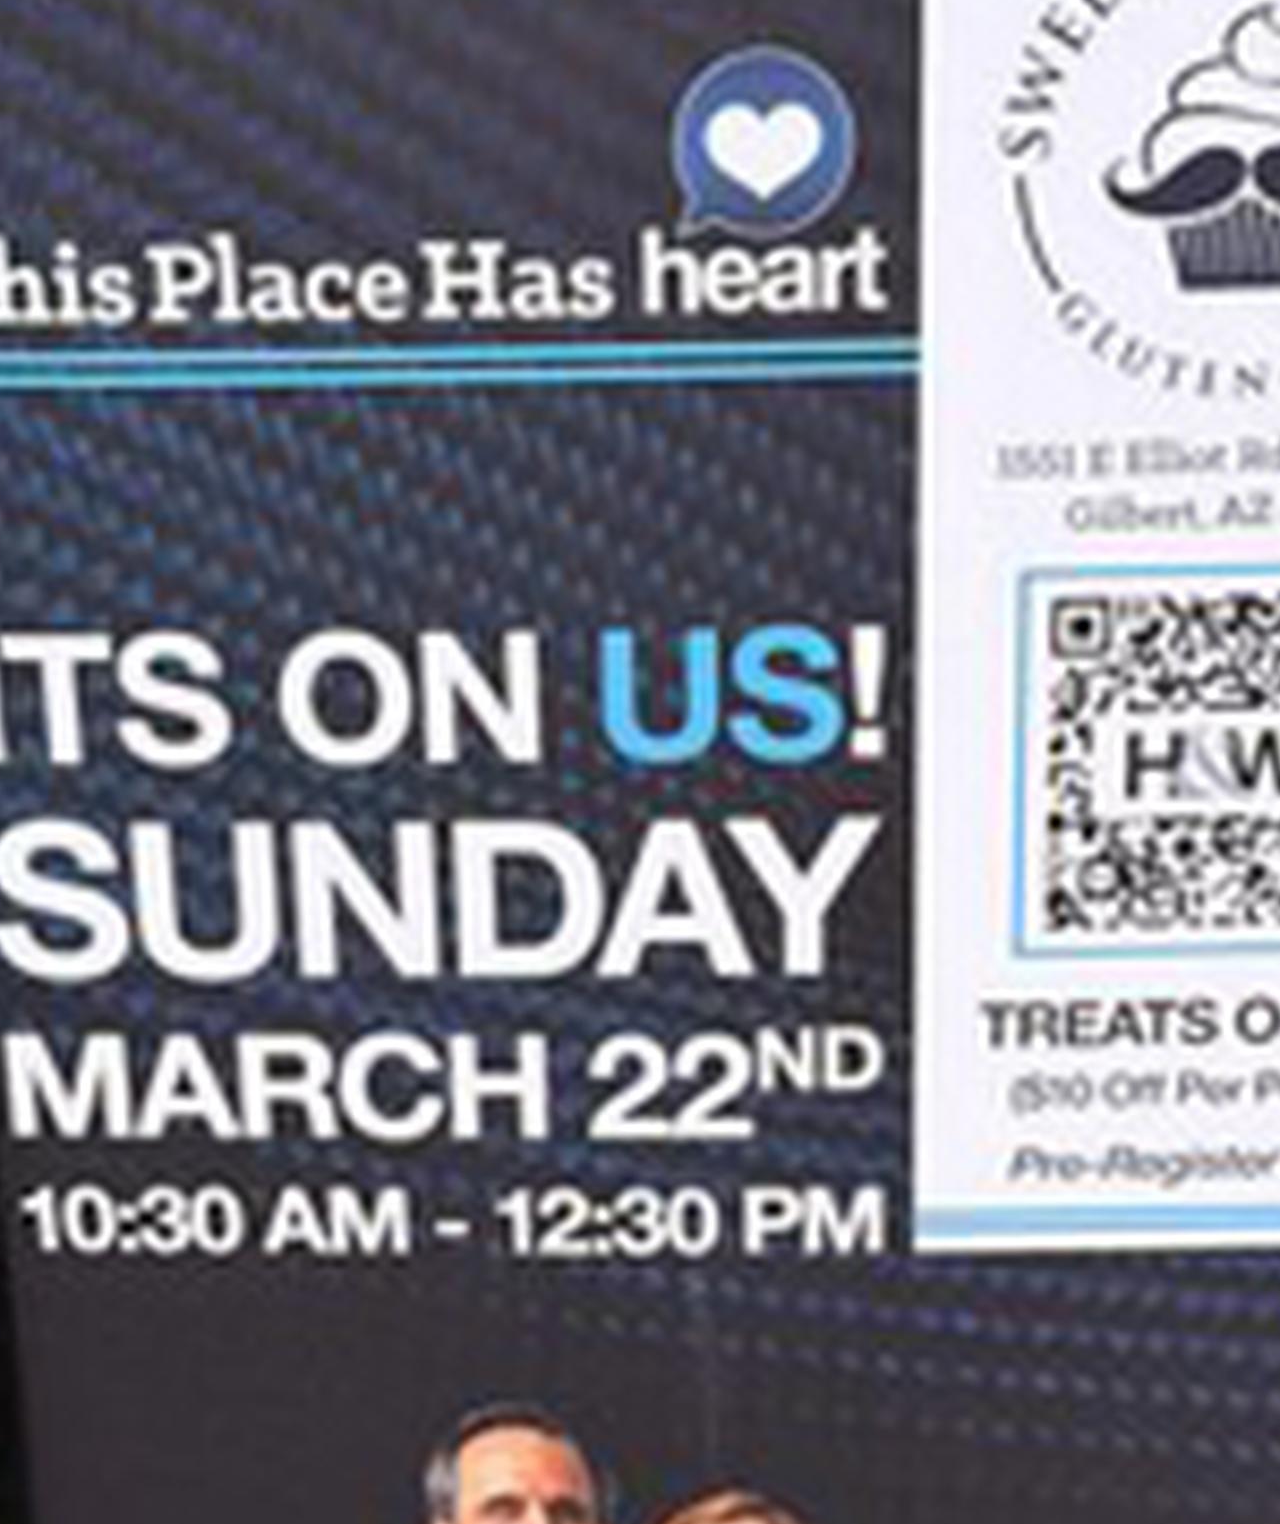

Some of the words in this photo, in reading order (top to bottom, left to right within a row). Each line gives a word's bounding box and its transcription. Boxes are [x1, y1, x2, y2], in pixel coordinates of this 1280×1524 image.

[146, 232, 407, 322] Place
[420, 238, 613, 320] Has
[641, 228, 888, 315] heart
[1219, 492, 1273, 525] AZ
[277, 627, 542, 767] ON
[597, 623, 887, 764] US!
[979, 998, 1219, 1048] TREATS
[2, 1029, 550, 1141] MARCH
[588, 1027, 884, 1141] 22ND
[1103, 1068, 1164, 1110] Off
[1176, 1067, 1242, 1106] Per
[1010, 1139, 1280, 1189] Pre-Register
[23, 1185, 243, 1255] 10:30
[264, 1185, 409, 1253] AM
[497, 1184, 717, 1255] 12:30
[743, 1185, 886, 1253] PM
